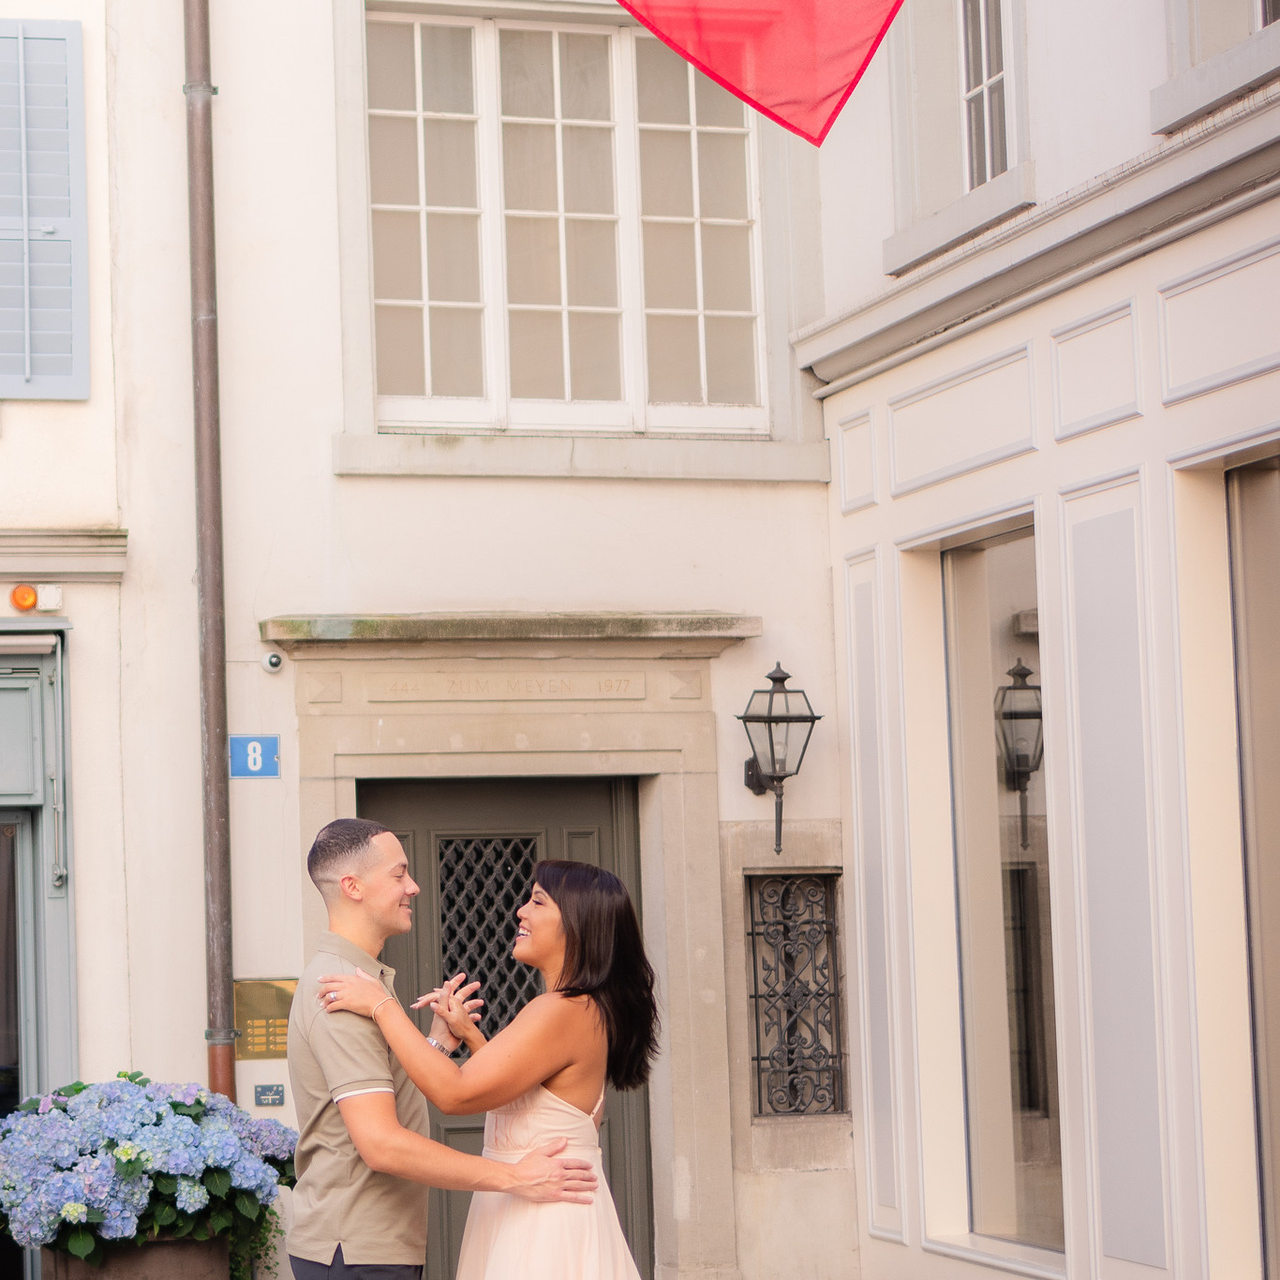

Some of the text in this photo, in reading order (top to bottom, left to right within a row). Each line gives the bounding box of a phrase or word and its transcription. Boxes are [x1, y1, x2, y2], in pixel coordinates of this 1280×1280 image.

[447, 679, 490, 694] ZUM
[506, 678, 573, 694] MEYEN
[597, 678, 631, 693] 1977
[247, 741, 262, 771] 8
